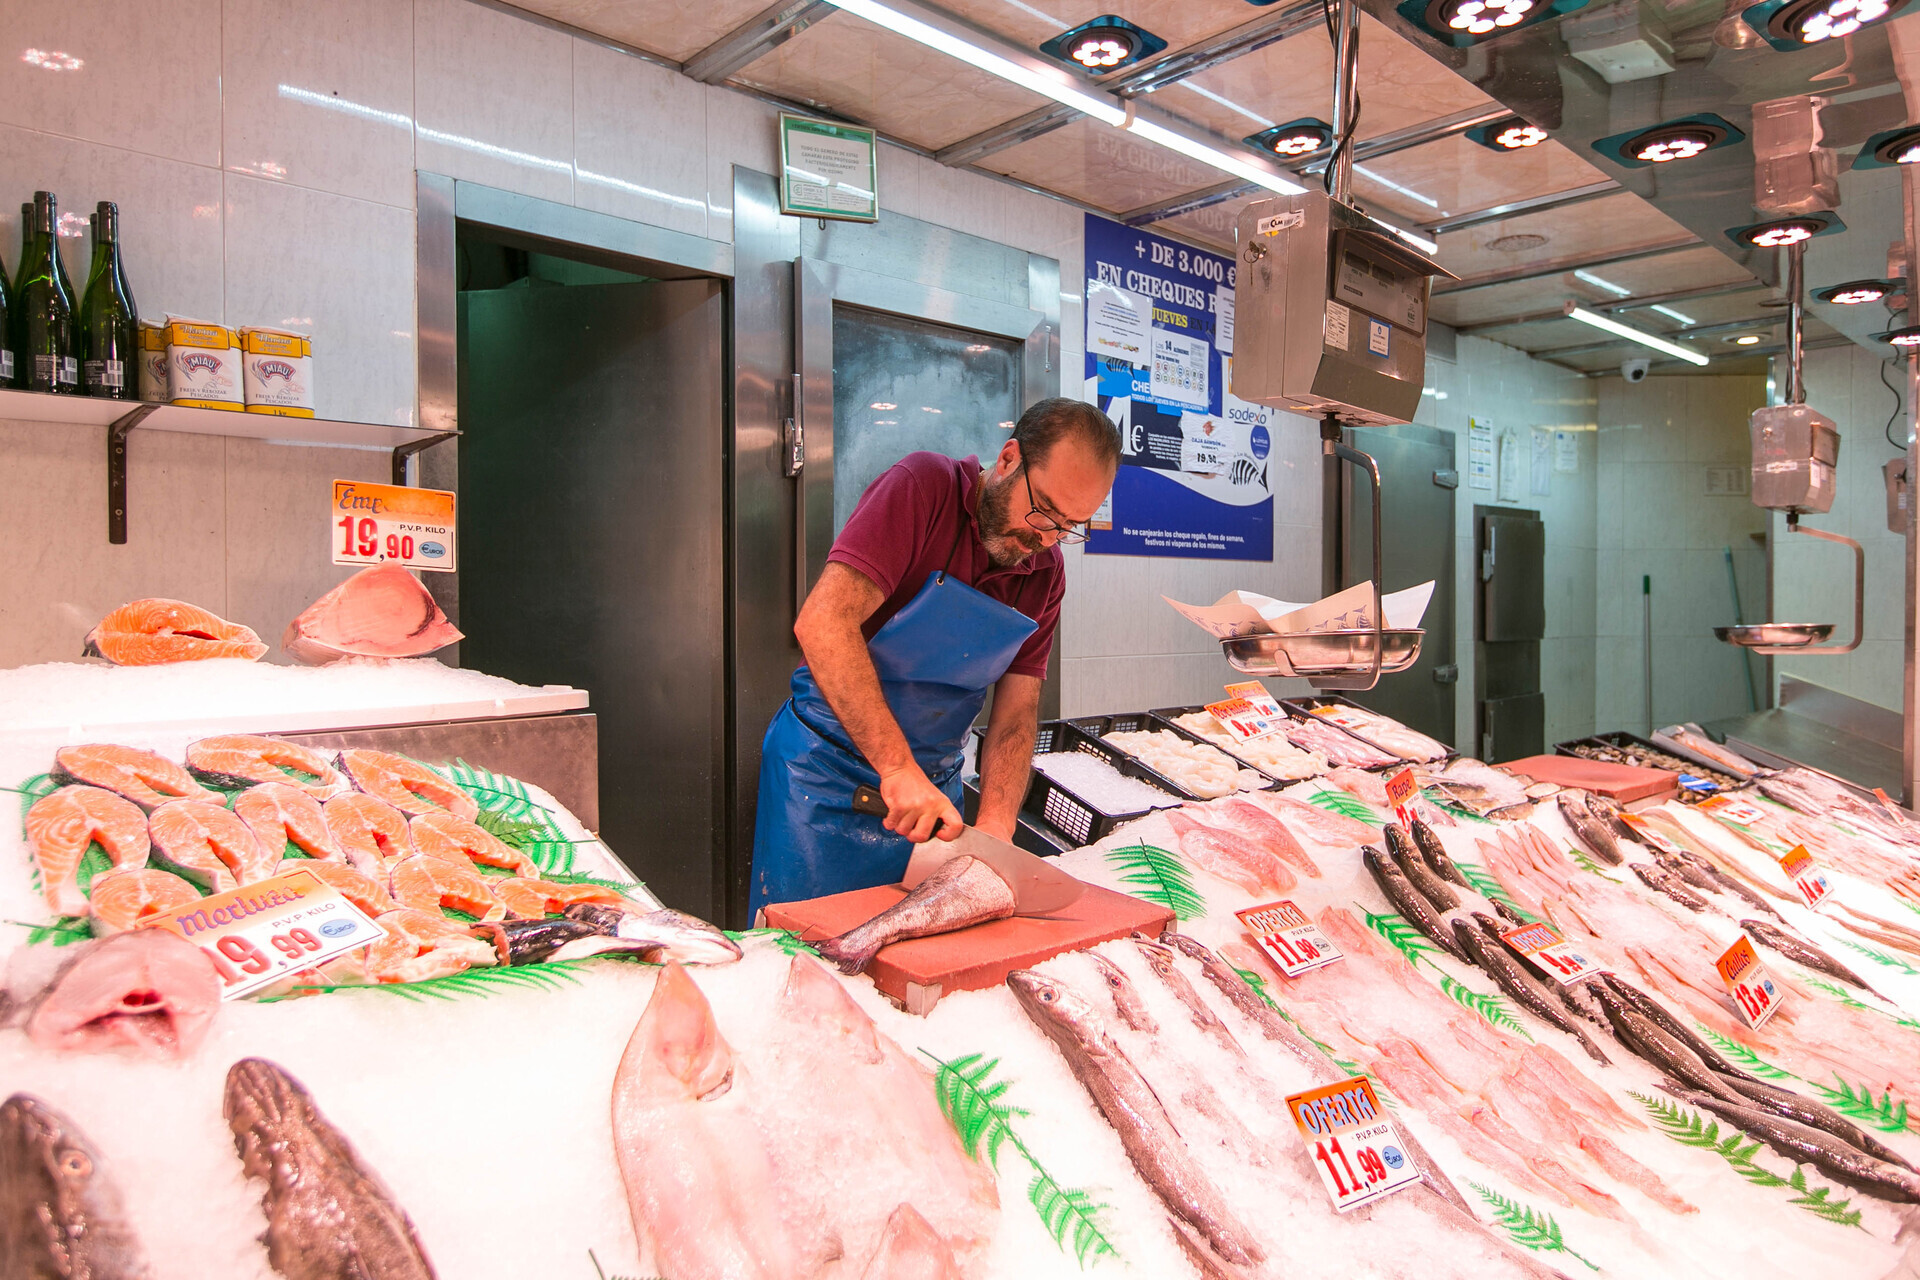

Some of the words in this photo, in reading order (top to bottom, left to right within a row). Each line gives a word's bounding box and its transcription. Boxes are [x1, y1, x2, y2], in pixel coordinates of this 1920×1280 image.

[1151, 241, 1174, 268] DE
[1178, 250, 1224, 283] 3.000
[1226, 266, 1236, 288] €
[1096, 260, 1122, 287] EN
[1126, 269, 1206, 311] CHEQUES
[1152, 307, 1188, 328] JUEVES
[1165, 340, 1172, 351] 14
[1131, 380, 1150, 394] CHE
[1228, 406, 1267, 424] sodexo
[338, 514, 414, 562] 19,90
[400, 524, 422, 532] P.V.P.
[1123, 527, 1132, 535] No
[1173, 531, 1190, 540] cheque
[1208, 532, 1218, 540] fines
[1144, 538, 1164, 546] festivos
[1392, 778, 1412, 800] Rape
[272, 914, 306, 928] P.V.P.
[308, 902, 336, 916] KILO
[1245, 904, 1306, 934] OFERTA
[1264, 932, 1320, 968] 11,98
[1510, 928, 1560, 952] OFERTA
[199, 927, 323, 987] 19,99
[1734, 983, 1770, 1022] 13,99
[1298, 1086, 1378, 1135] OFERTA
[1355, 1130, 1374, 1142] P.V.P.
[1374, 1124, 1388, 1136] KILO
[1315, 1136, 1388, 1198] 11,99
